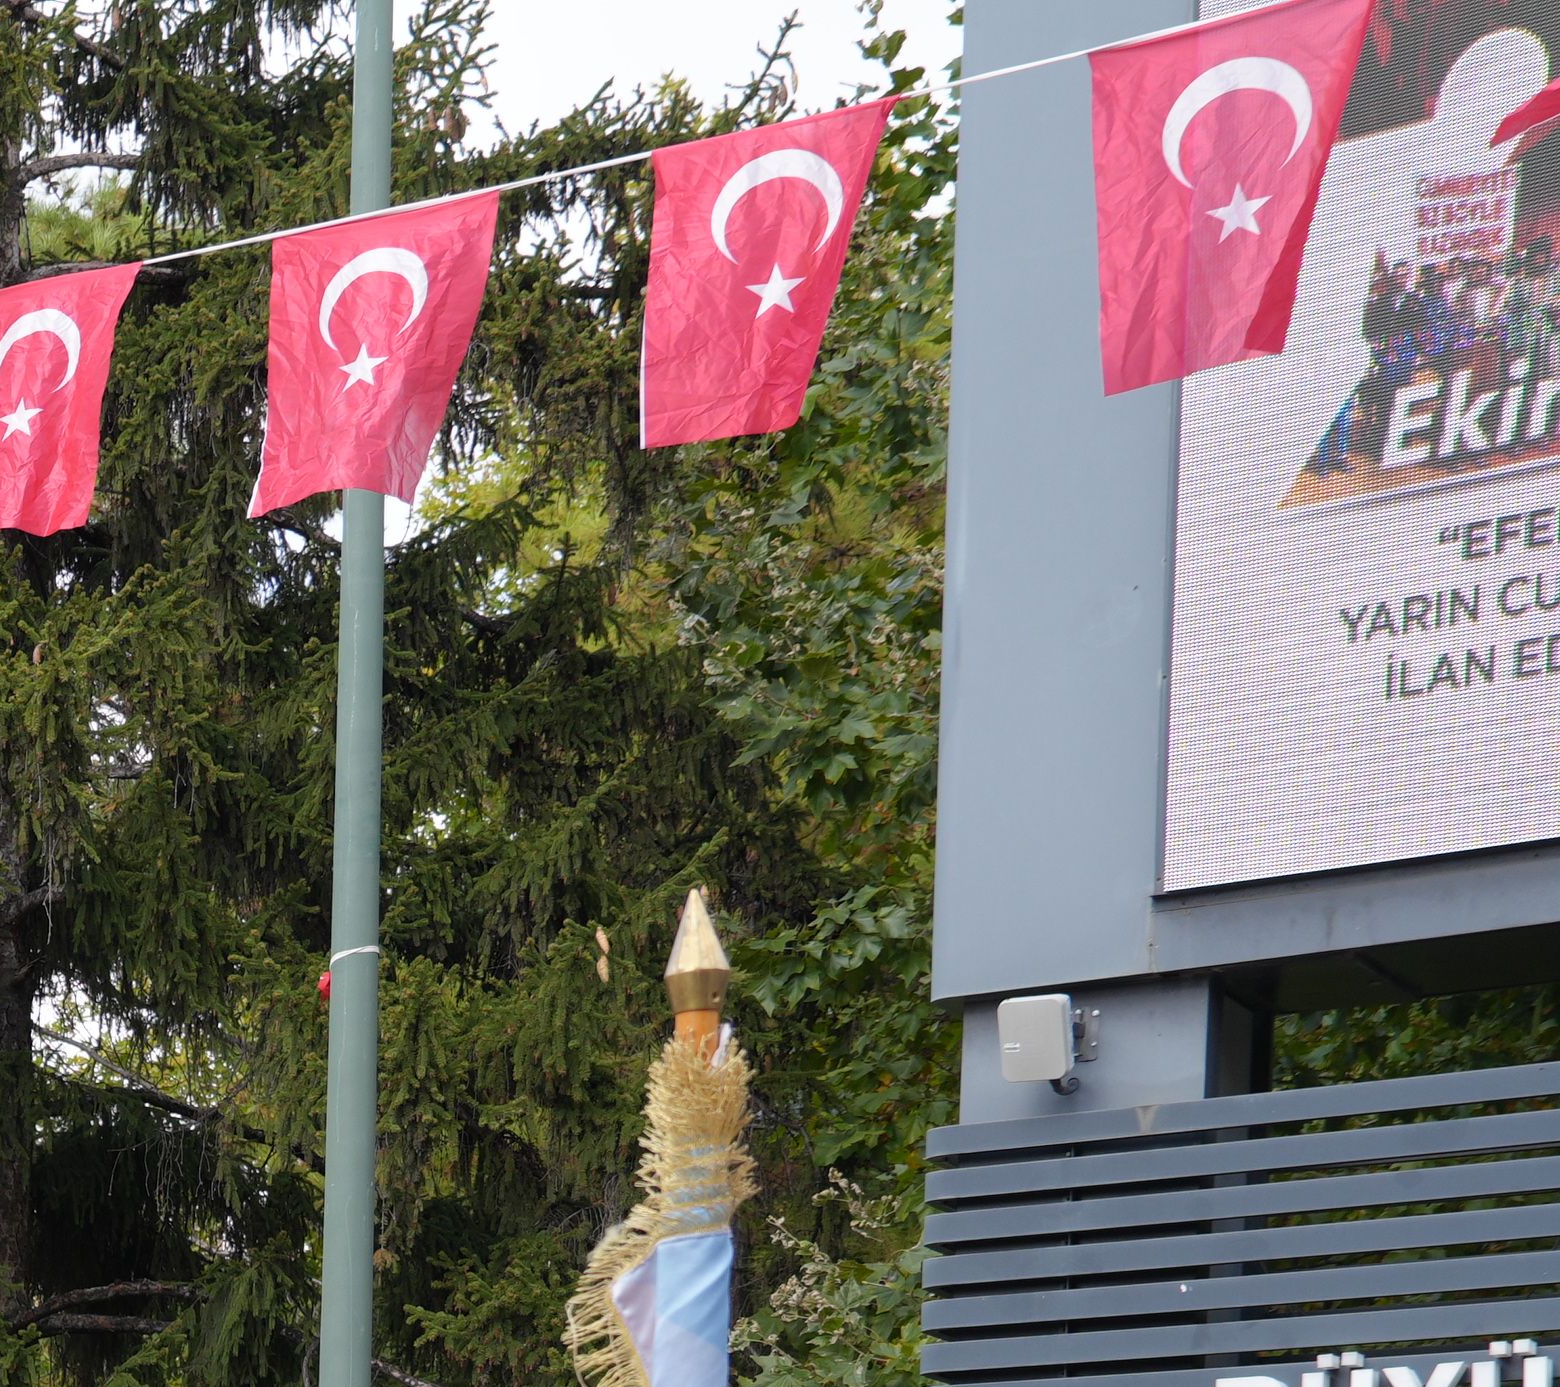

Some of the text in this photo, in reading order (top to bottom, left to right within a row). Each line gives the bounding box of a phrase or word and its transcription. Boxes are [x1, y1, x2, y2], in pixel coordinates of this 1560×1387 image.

[1437, 508, 1560, 561] “EFE
[1339, 585, 1480, 644] YARIN
[1385, 645, 1496, 701] İLAN
